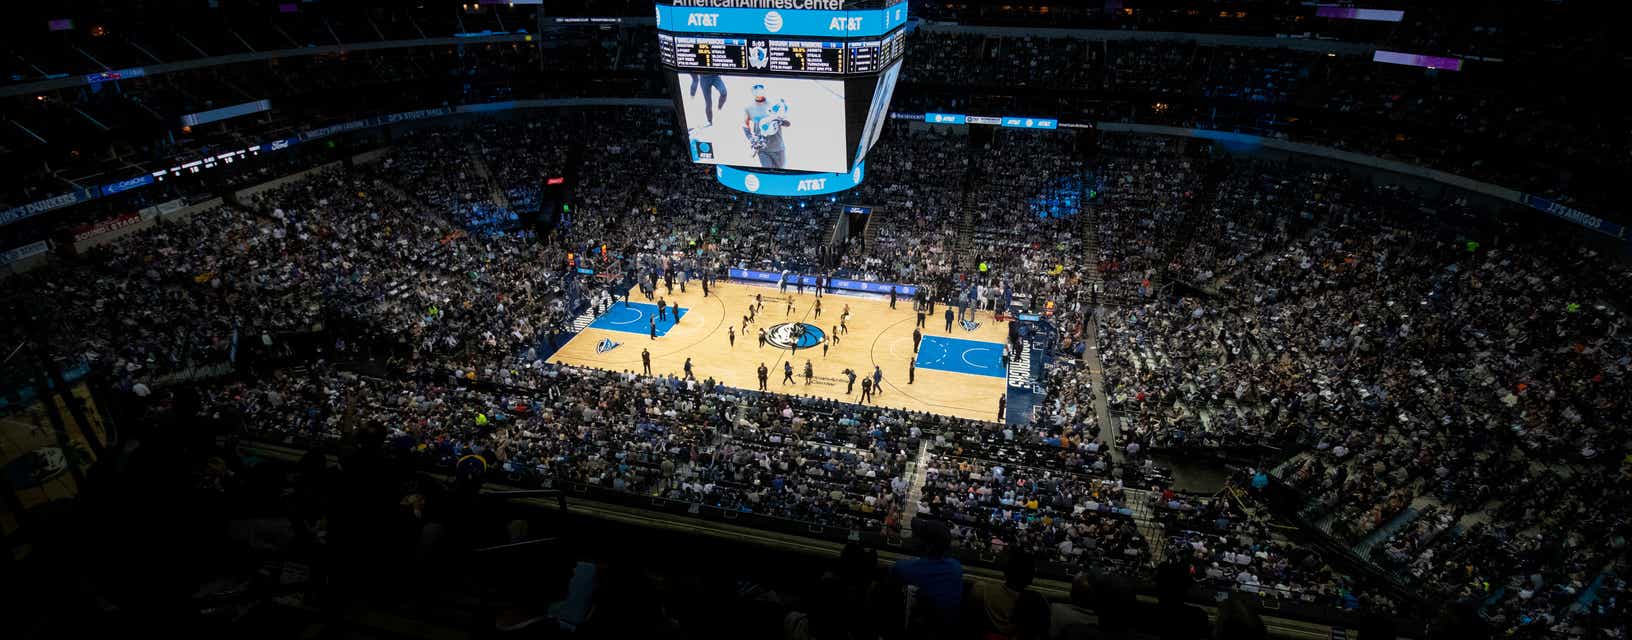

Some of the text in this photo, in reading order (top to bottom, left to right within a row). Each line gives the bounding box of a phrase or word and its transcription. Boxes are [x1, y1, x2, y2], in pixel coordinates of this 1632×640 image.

[687, 13, 719, 27] AT&T
[829, 17, 863, 31] AT&T
[271, 140, 288, 151] Ford
[797, 178, 827, 192] AT&T
[27, 192, 77, 215] DUNKERS
